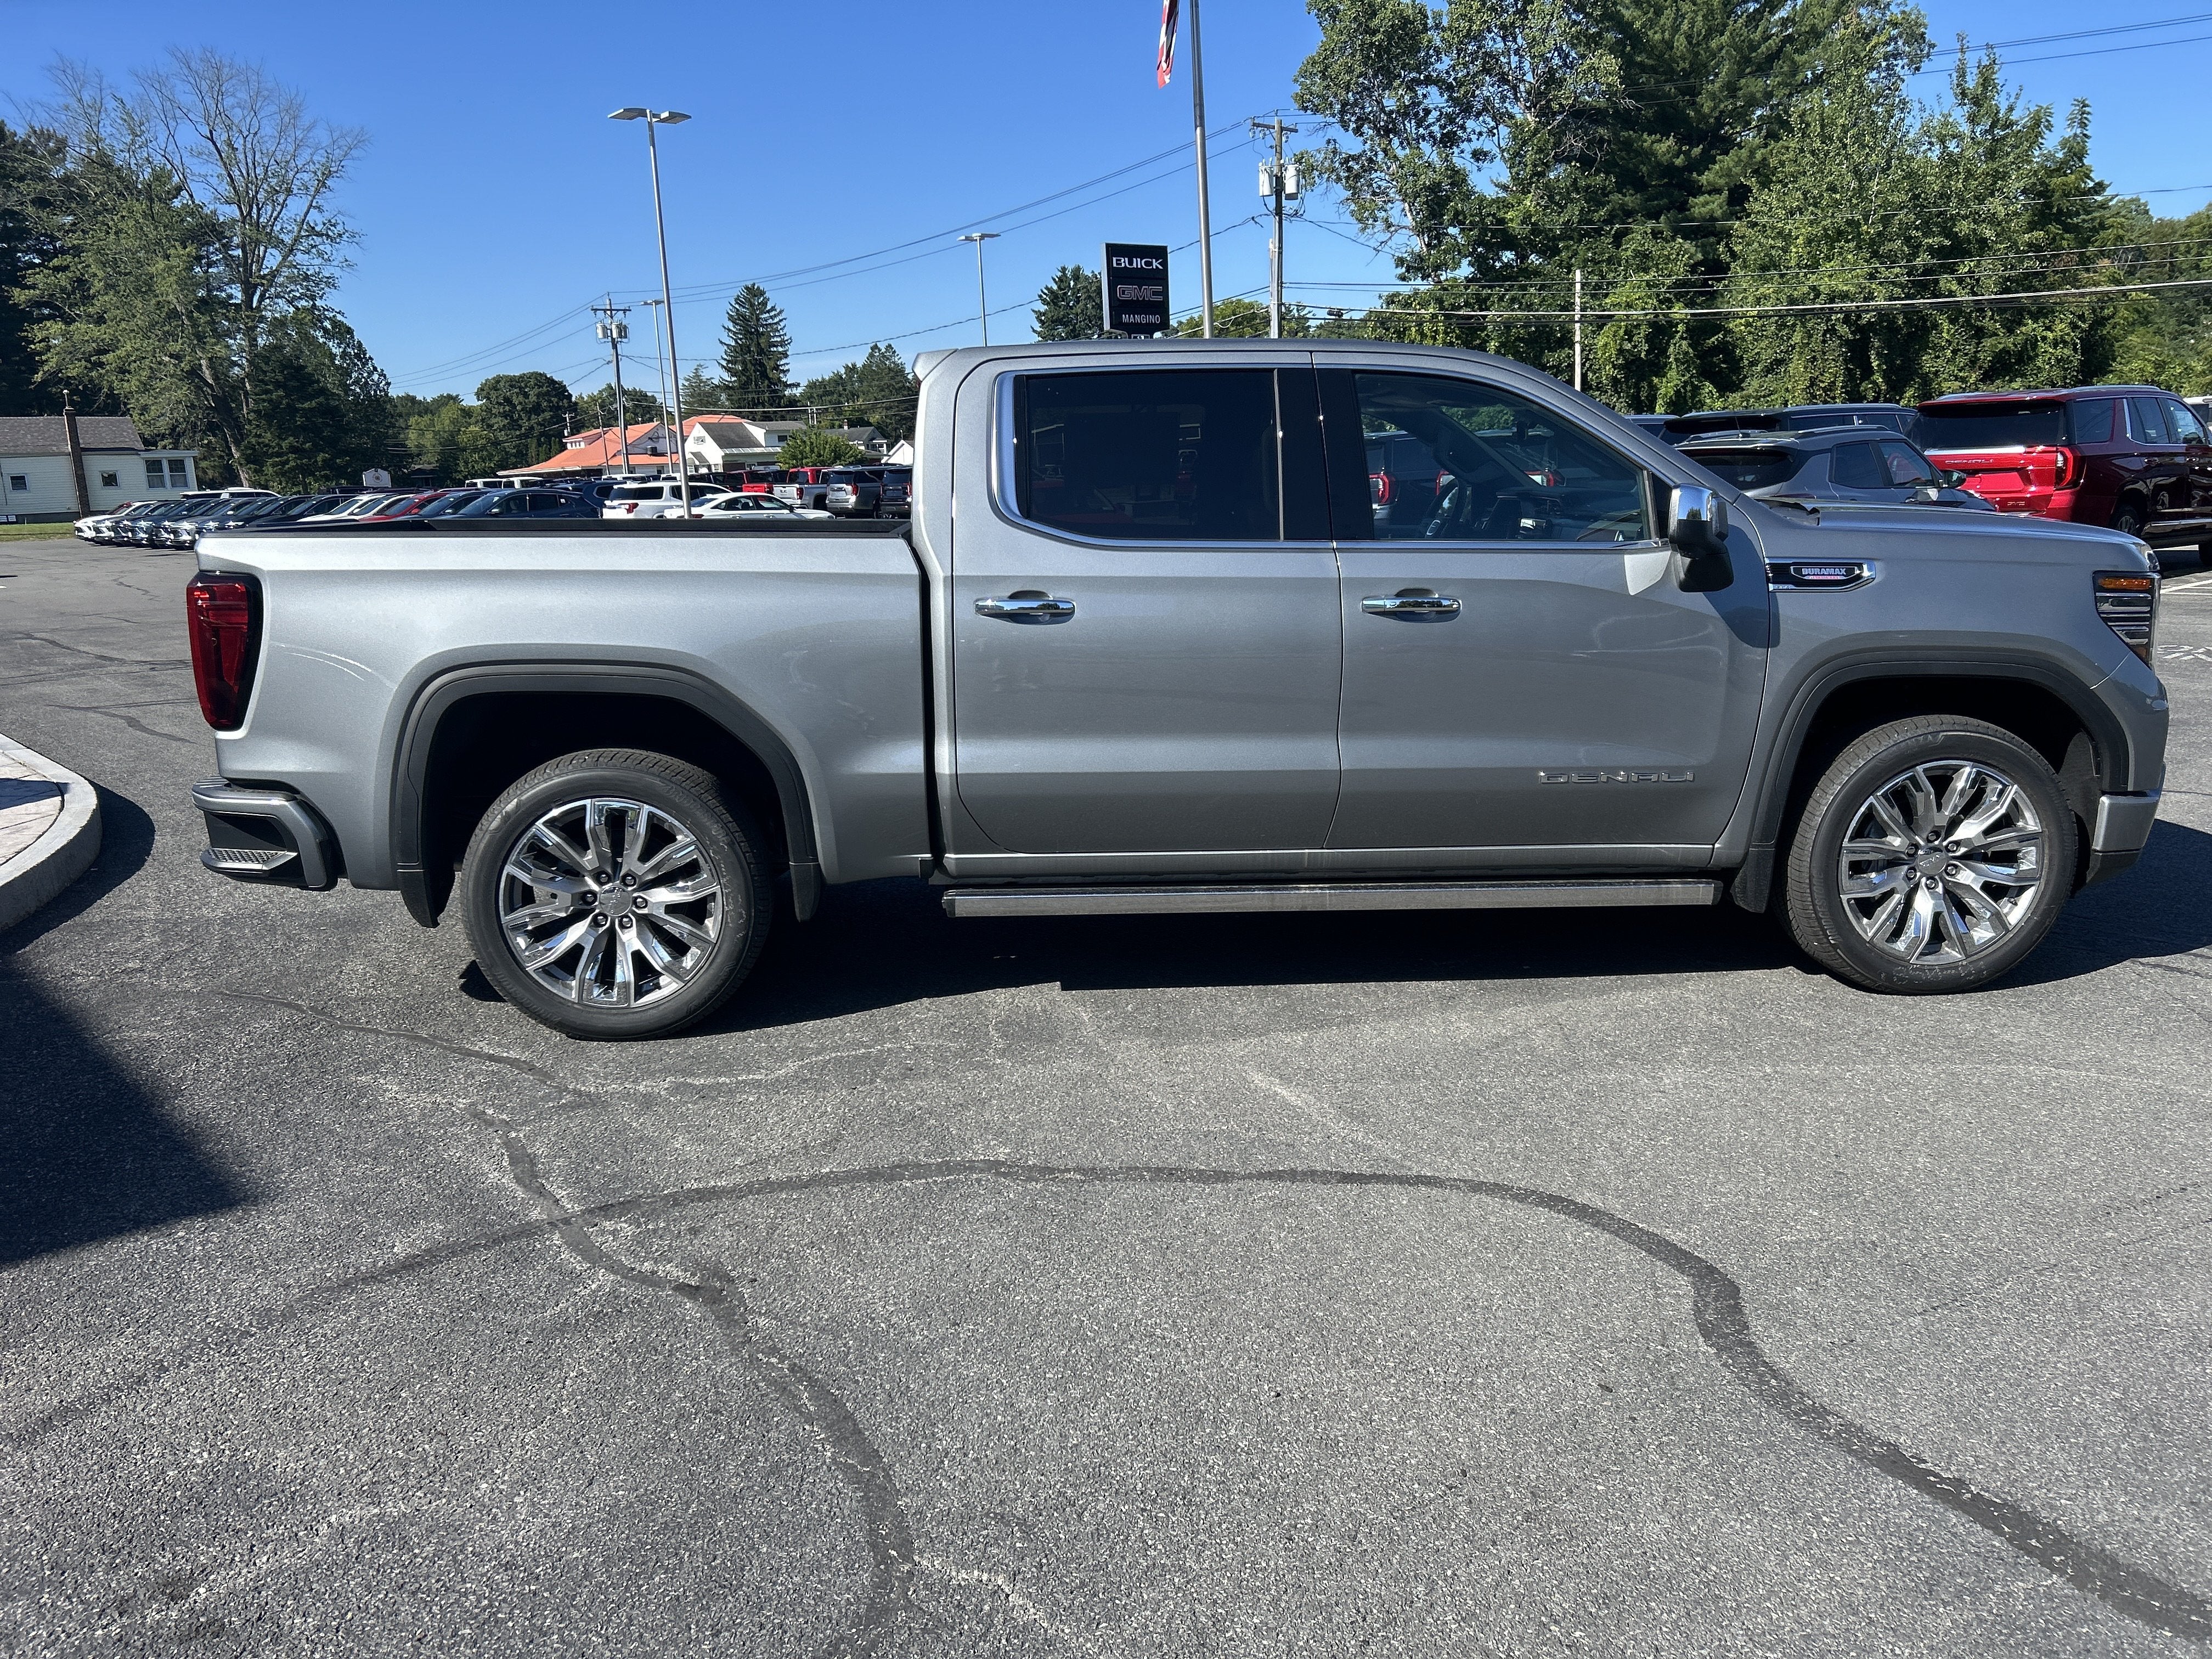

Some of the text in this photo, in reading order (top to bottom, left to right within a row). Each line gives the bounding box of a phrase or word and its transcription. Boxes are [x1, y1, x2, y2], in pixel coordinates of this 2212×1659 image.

[1113, 256, 1163, 269] BUICK
[1117, 285, 1163, 301] GMC
[1122, 314, 1160, 324] MANGINO
[1539, 770, 1695, 784] DENALI
